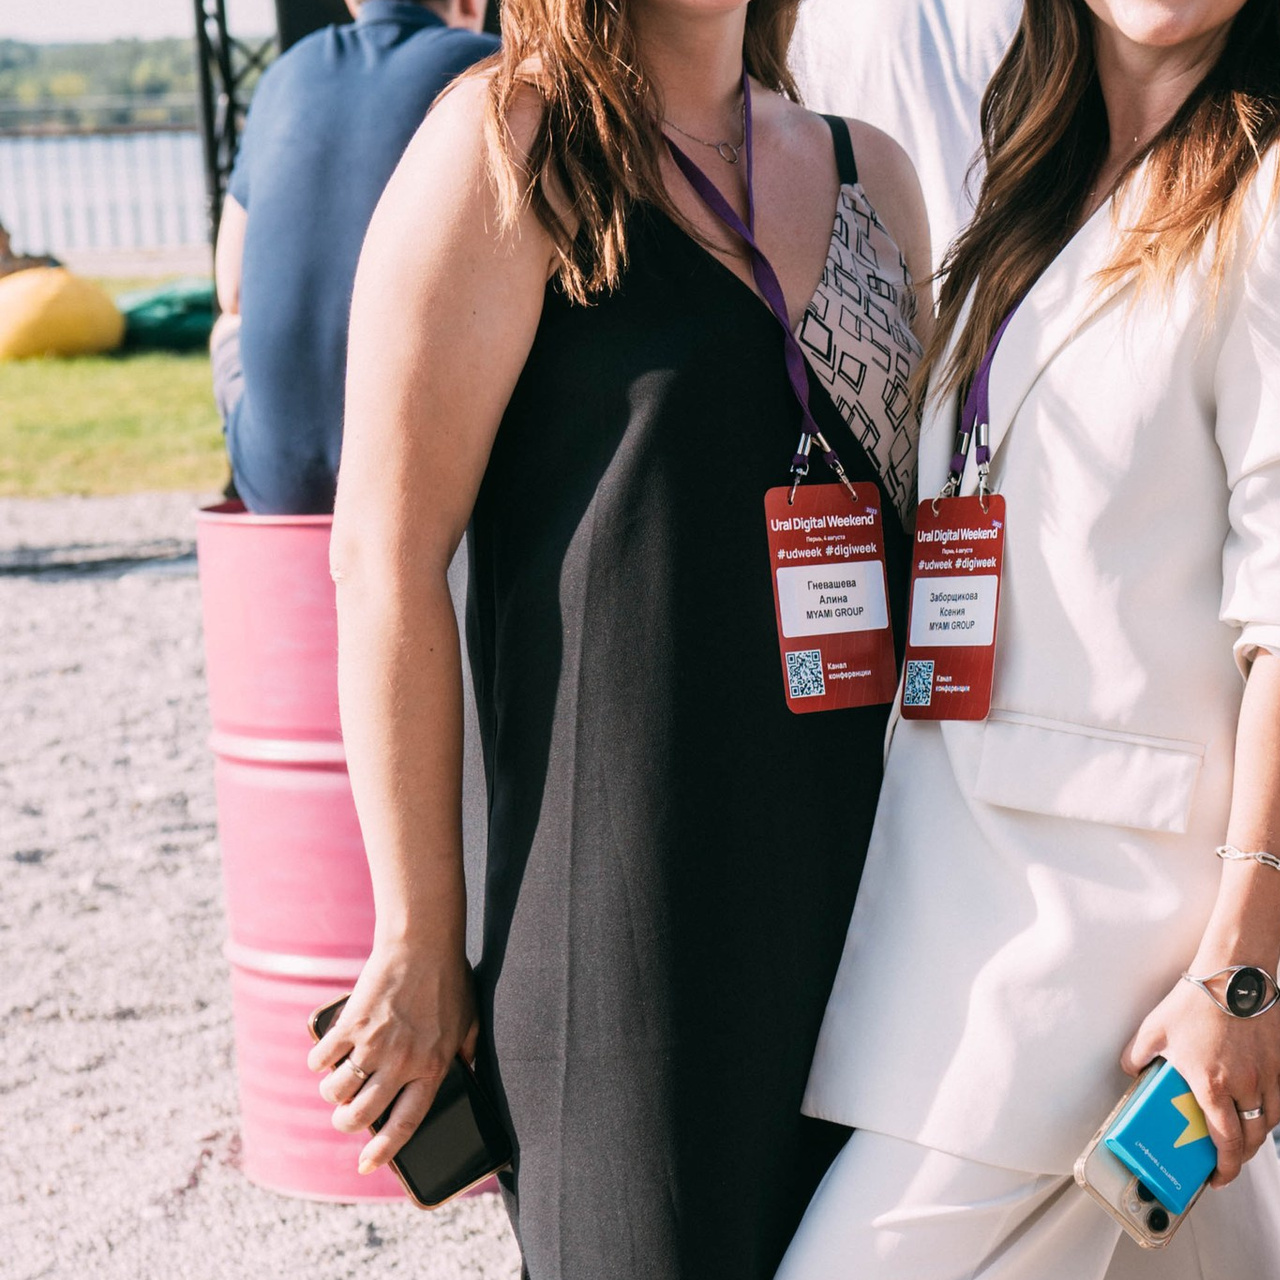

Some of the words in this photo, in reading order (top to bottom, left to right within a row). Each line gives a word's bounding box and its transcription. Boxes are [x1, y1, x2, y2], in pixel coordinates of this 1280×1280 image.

[771, 518, 792, 532] Ural
[793, 516, 826, 532] Digital
[827, 514, 874, 528] Weekend
[917, 530, 933, 542] Ural
[934, 528, 960, 545] Digital
[960, 526, 998, 540] Weekend
[777, 547, 822, 559] #udweek
[825, 542, 877, 557] #digiweek
[918, 559, 953, 570] #udweek
[955, 556, 997, 571] #digiweek
[807, 580, 856, 590] Гневашева
[819, 595, 848, 604] Алина
[806, 609, 833, 619] MYAMI
[835, 606, 864, 617] GROUP
[939, 607, 965, 616] Ксения
[929, 621, 950, 630] MYAMI
[951, 620, 975, 630] GROUP
[827, 662, 847, 670] Канал
[828, 670, 871, 680] конференции
